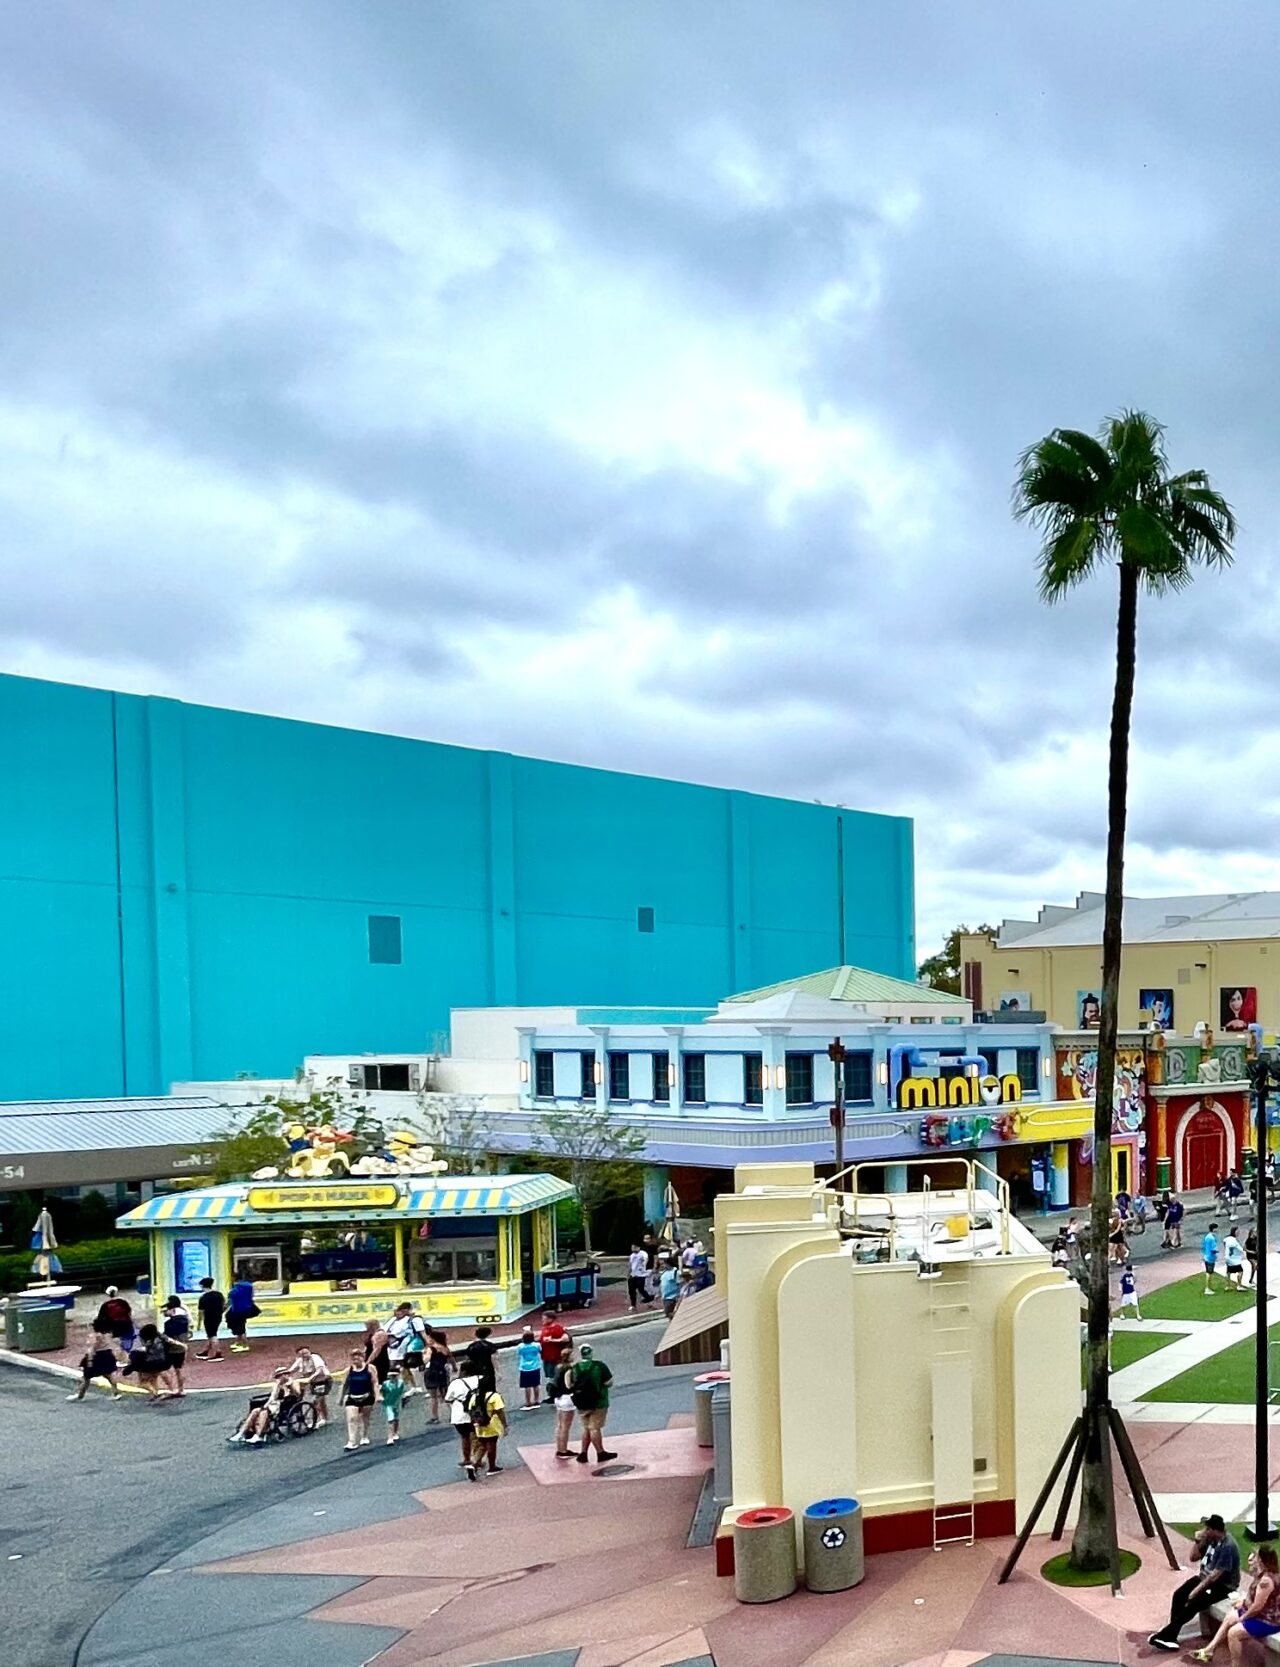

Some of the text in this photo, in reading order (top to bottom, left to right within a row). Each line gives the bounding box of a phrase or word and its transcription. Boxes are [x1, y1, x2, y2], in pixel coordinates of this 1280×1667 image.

[279, 1193, 310, 1202] POP
[313, 1192, 321, 1200] A
[317, 1300, 420, 1315] POP A NAA
